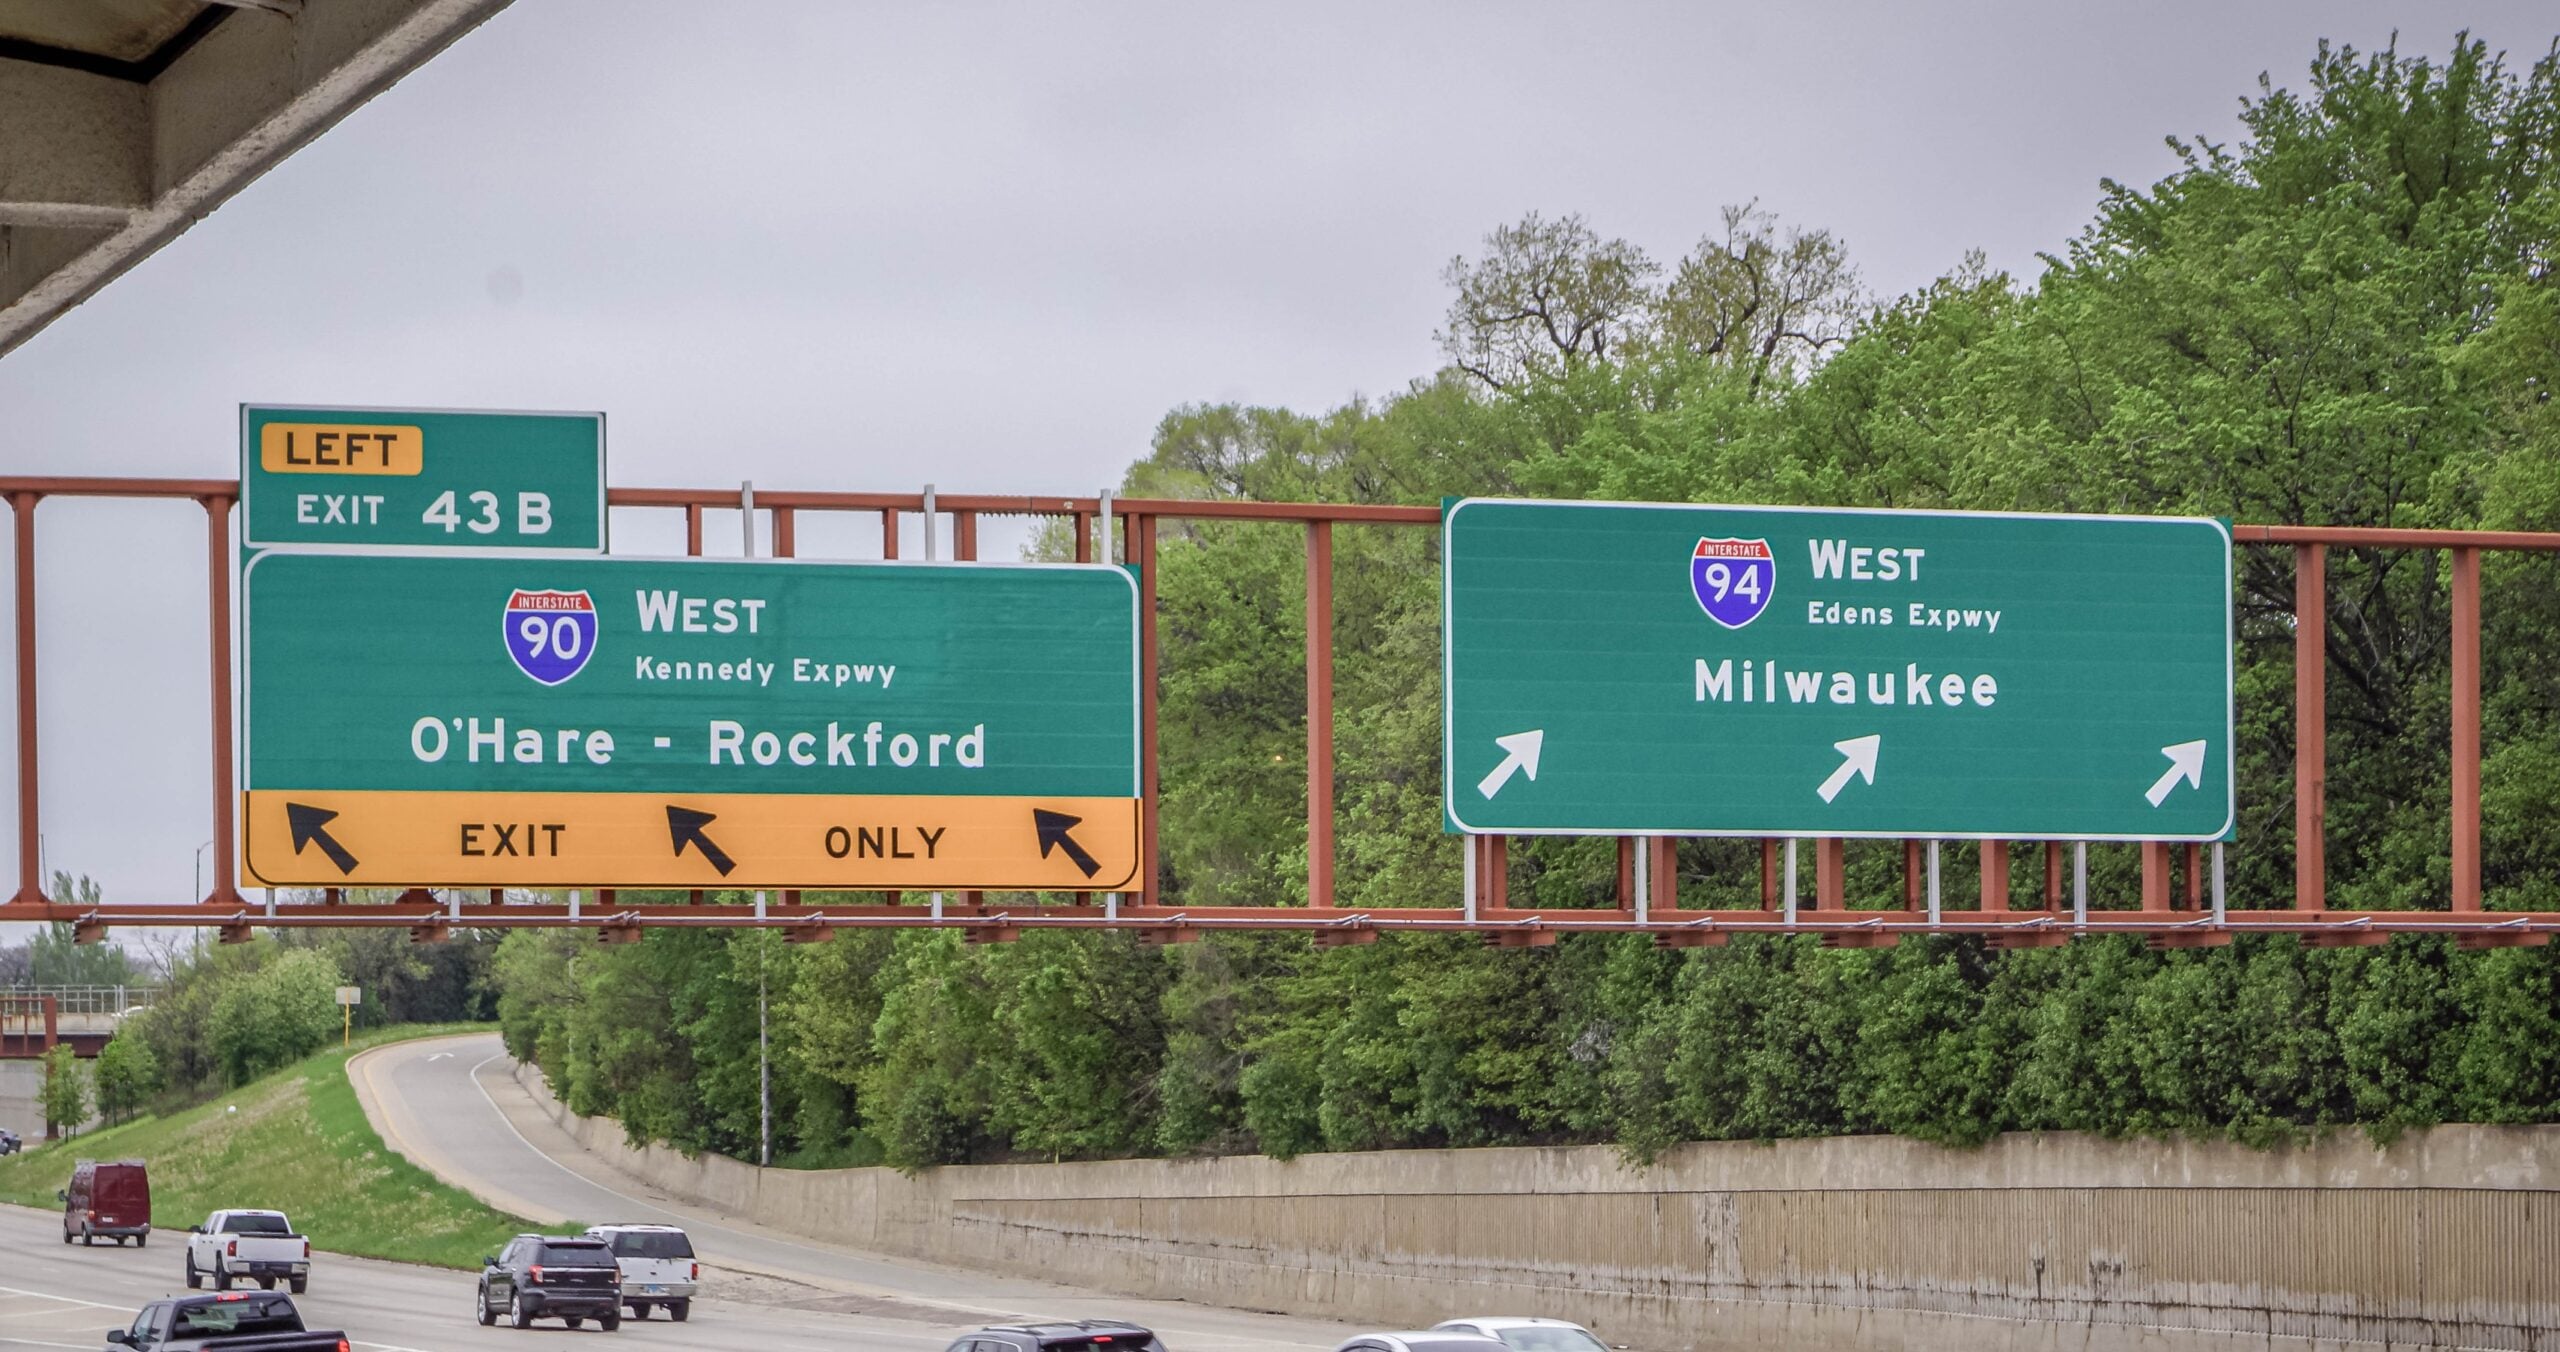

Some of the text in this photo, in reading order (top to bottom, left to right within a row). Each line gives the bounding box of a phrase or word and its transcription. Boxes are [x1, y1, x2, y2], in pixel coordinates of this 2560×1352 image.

[286, 431, 398, 467] LEFT
[298, 495, 384, 524] EXIT
[1704, 543, 1761, 557] INTERSTATE
[1809, 539, 1924, 580] WEST
[1704, 562, 1762, 605] 94
[518, 595, 582, 610] INTERSTATE
[636, 590, 765, 633] WEST
[1809, 602, 2000, 633] Edens Expwy
[519, 615, 581, 660] 90
[637, 656, 895, 688] Kennedy Expwy
[1696, 659, 1997, 706] Milwaukee
[412, 717, 614, 764] O'Hare
[710, 721, 983, 767] Rockford
[462, 824, 945, 858] EXIT ONLY
